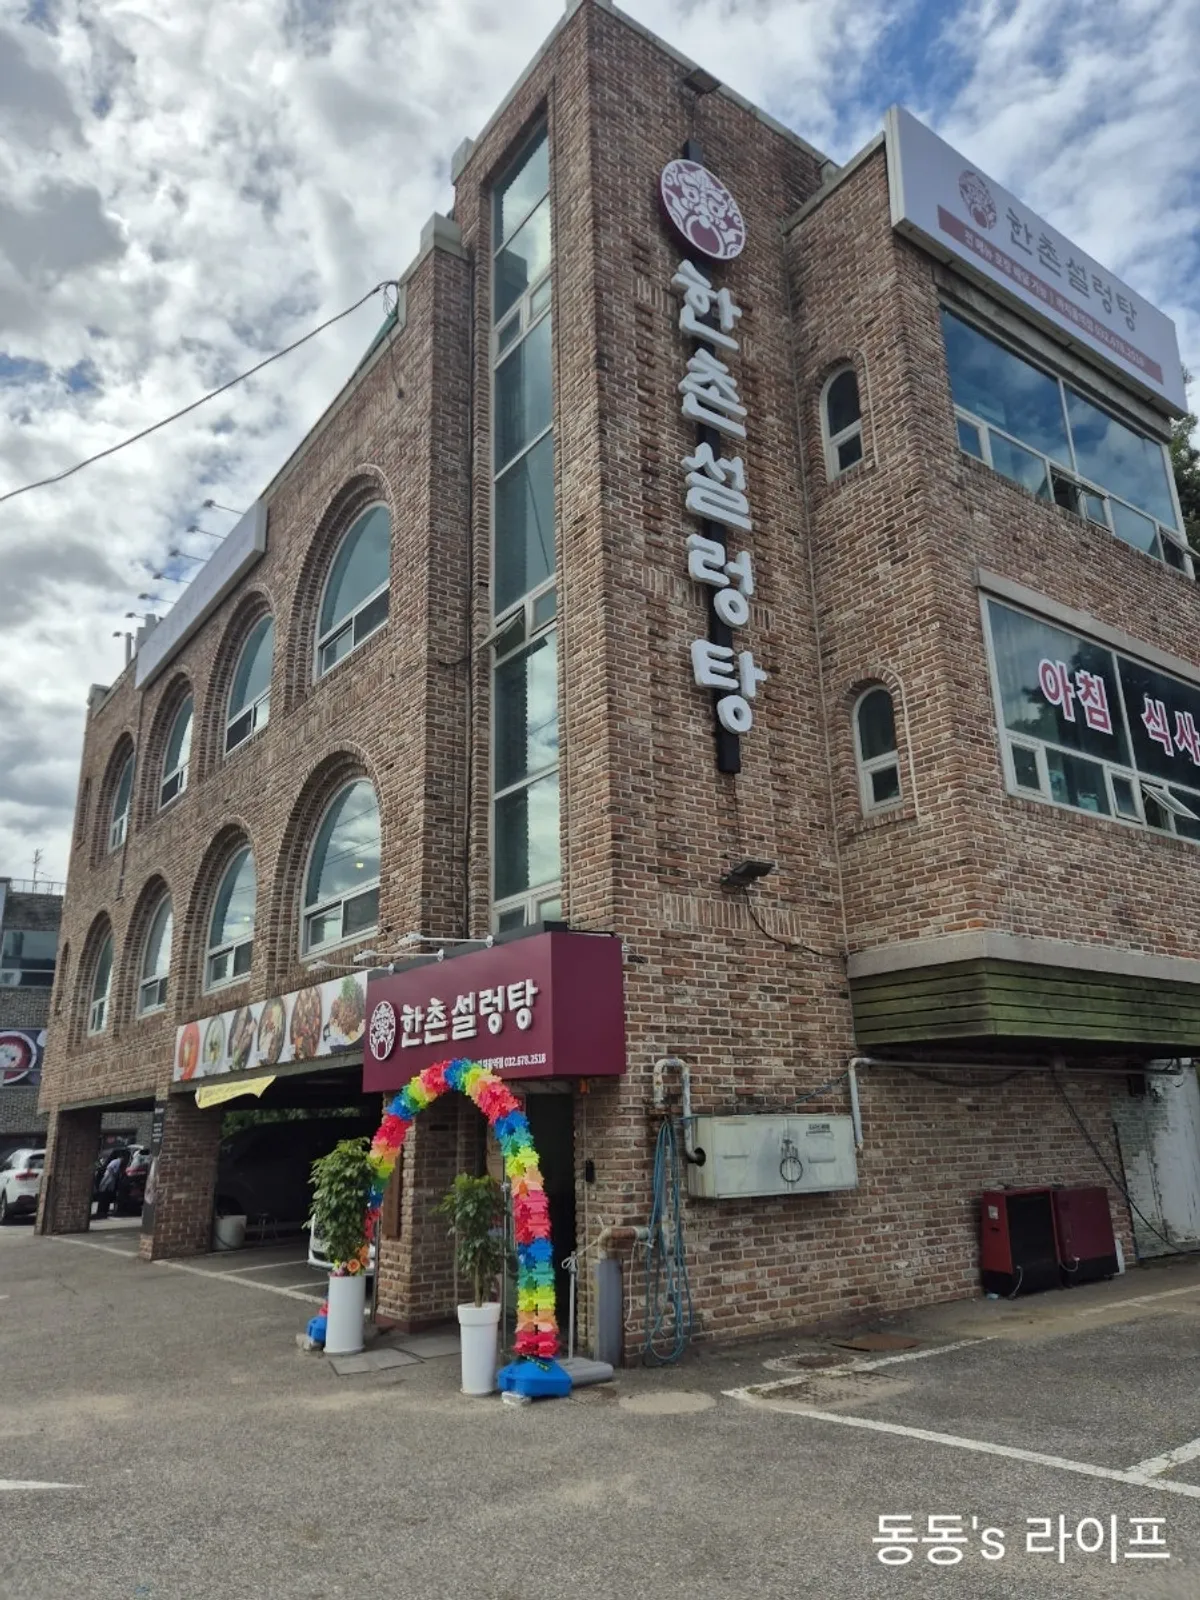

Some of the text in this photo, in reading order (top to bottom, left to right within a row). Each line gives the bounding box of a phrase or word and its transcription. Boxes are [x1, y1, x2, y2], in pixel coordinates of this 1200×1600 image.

[1006, 207, 1138, 332] 한촌설렁탕
[671, 259, 767, 734] 한촌설렁탕
[1038, 658, 1200, 767] 아침 식사
[401, 979, 538, 1049] 한촌설렁탕
